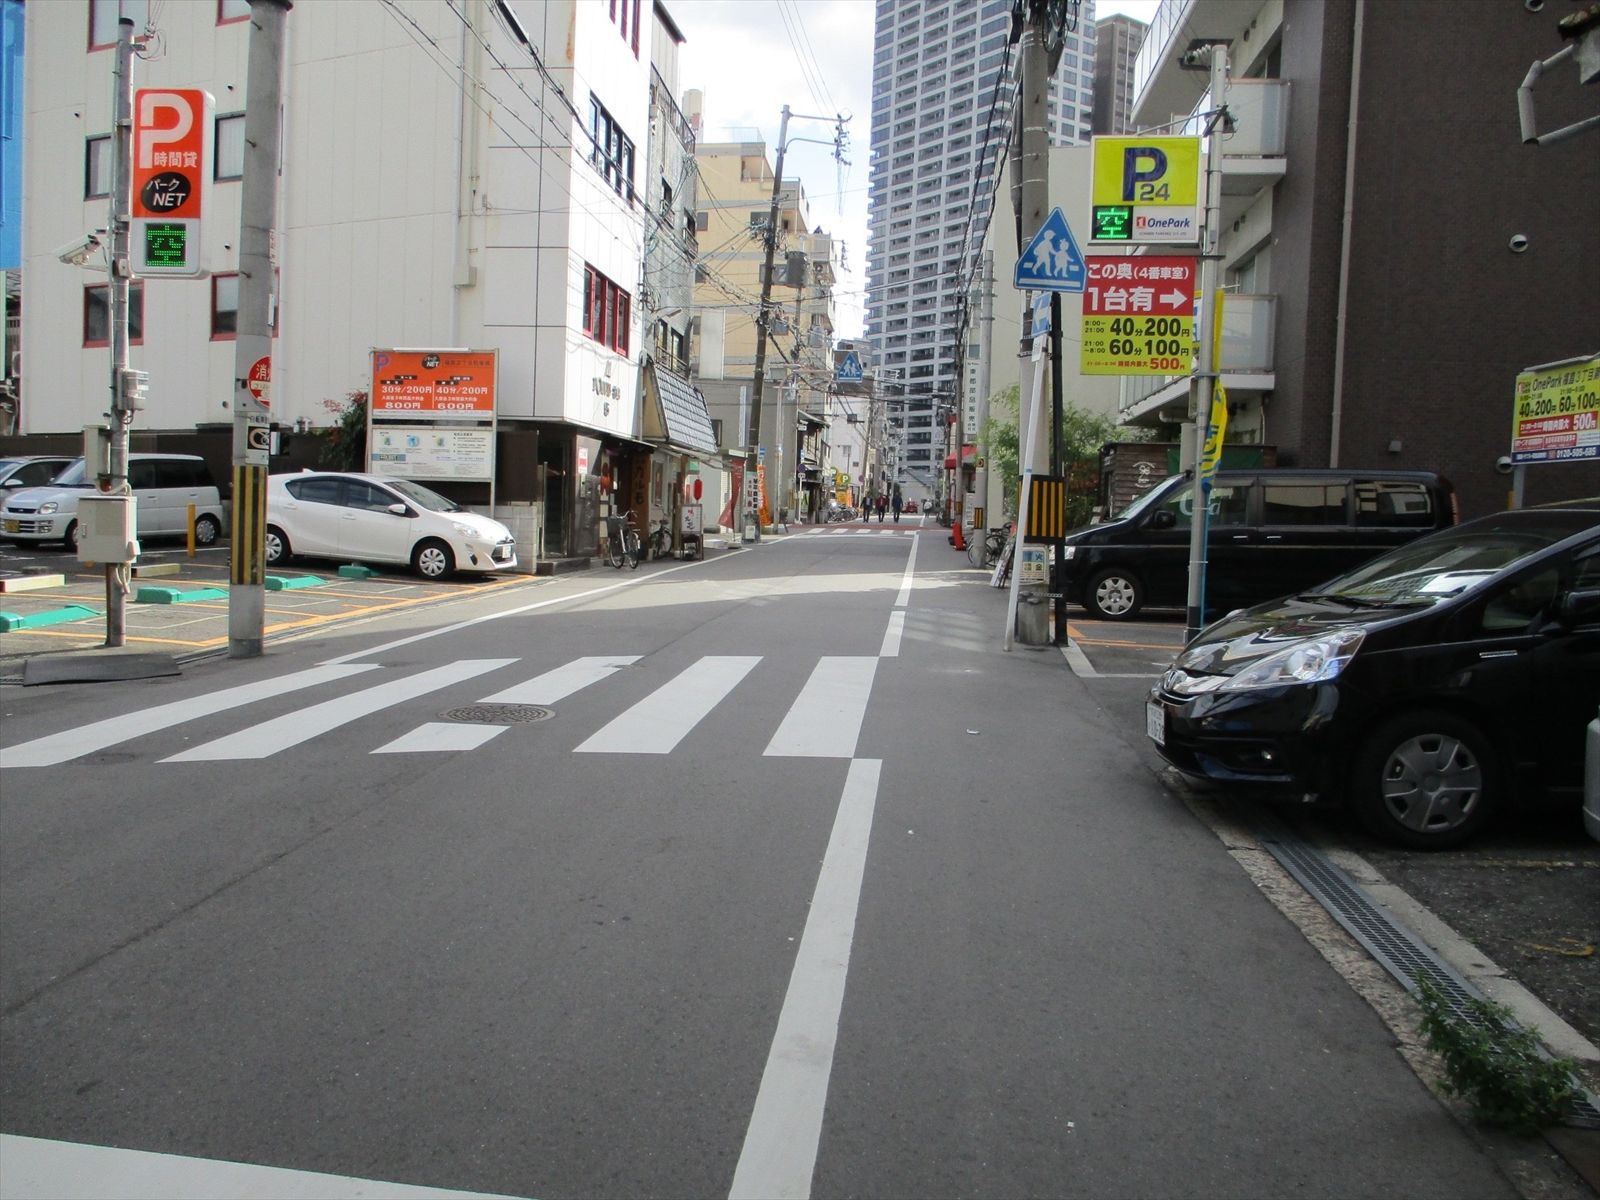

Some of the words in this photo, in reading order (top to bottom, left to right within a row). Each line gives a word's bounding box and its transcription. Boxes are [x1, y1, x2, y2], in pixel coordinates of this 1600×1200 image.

[139, 93, 193, 169] P
[153, 152, 198, 168] 時間貸
[146, 179, 181, 191] パーク
[1122, 147, 1168, 201] P
[153, 193, 186, 206] NET
[1140, 183, 1170, 201] 24
[1096, 207, 1129, 239] 空
[1147, 218, 1190, 228] OnePark
[146, 225, 188, 267] 空
[1088, 286, 1155, 312] 1台有
